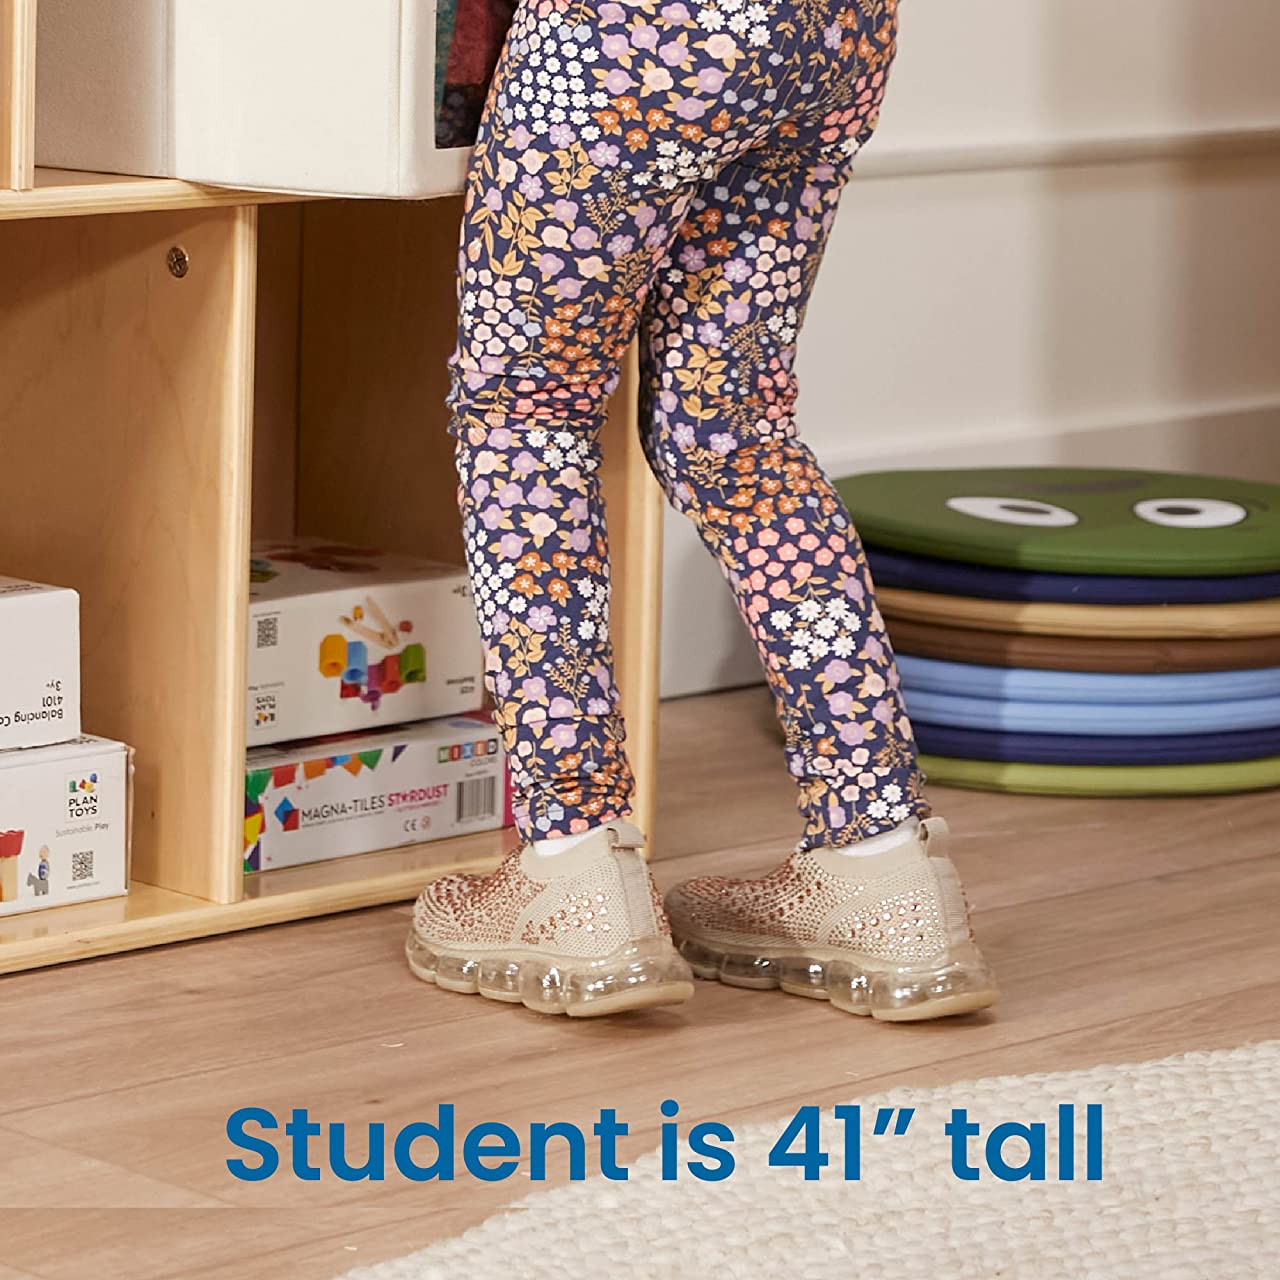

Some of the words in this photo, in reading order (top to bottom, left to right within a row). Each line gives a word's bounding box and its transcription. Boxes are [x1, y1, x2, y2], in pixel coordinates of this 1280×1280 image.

[42, 696, 63, 707] 4101
[14, 708, 63, 724] Balancing
[68, 795, 98, 807] PLAN
[68, 806, 98, 818] TOYS
[301, 795, 385, 821] MAGNA-TILES
